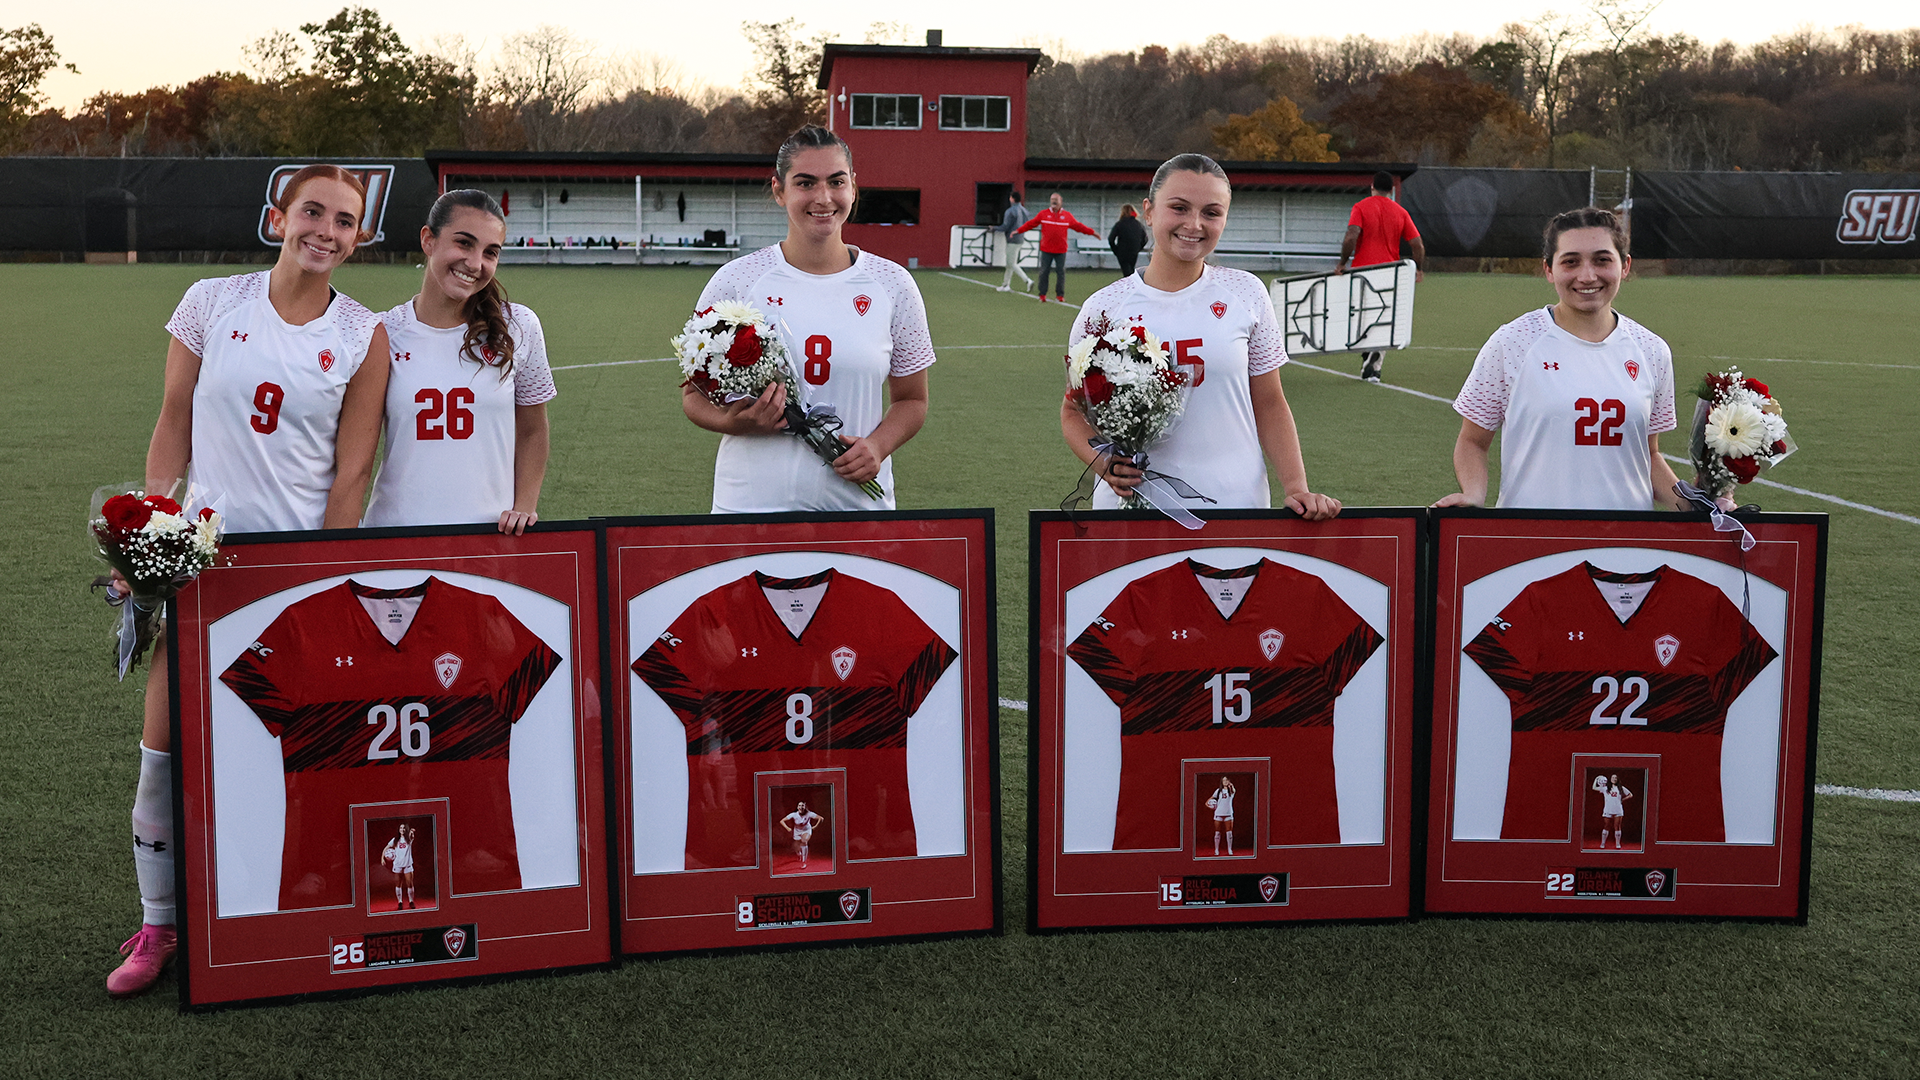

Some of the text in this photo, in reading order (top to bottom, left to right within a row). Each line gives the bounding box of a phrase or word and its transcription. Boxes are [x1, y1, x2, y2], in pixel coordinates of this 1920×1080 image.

[1841, 192, 1917, 240] SFU
[804, 334, 832, 386] 8
[250, 381, 284, 435] 9
[415, 387, 475, 440] 26
[1574, 397, 1626, 446] 22
[1204, 673, 1251, 724] 15
[1589, 676, 1650, 726] 22
[785, 693, 814, 744] 8
[367, 702, 430, 760] 26
[1186, 880, 1212, 889] RILEY
[1547, 873, 1575, 891] 22
[1577, 871, 1620, 880] DELANEY
[1577, 880, 1623, 892] URBAN
[757, 896, 811, 909] CATERINA
[1161, 883, 1183, 901] 15
[1186, 888, 1237, 900] CERQUA
[738, 902, 753, 923] 8
[757, 905, 821, 922] SCHIAVO
[367, 933, 424, 948] MERCEDEZ
[333, 942, 364, 965] 26
[367, 945, 412, 960] PAINO
